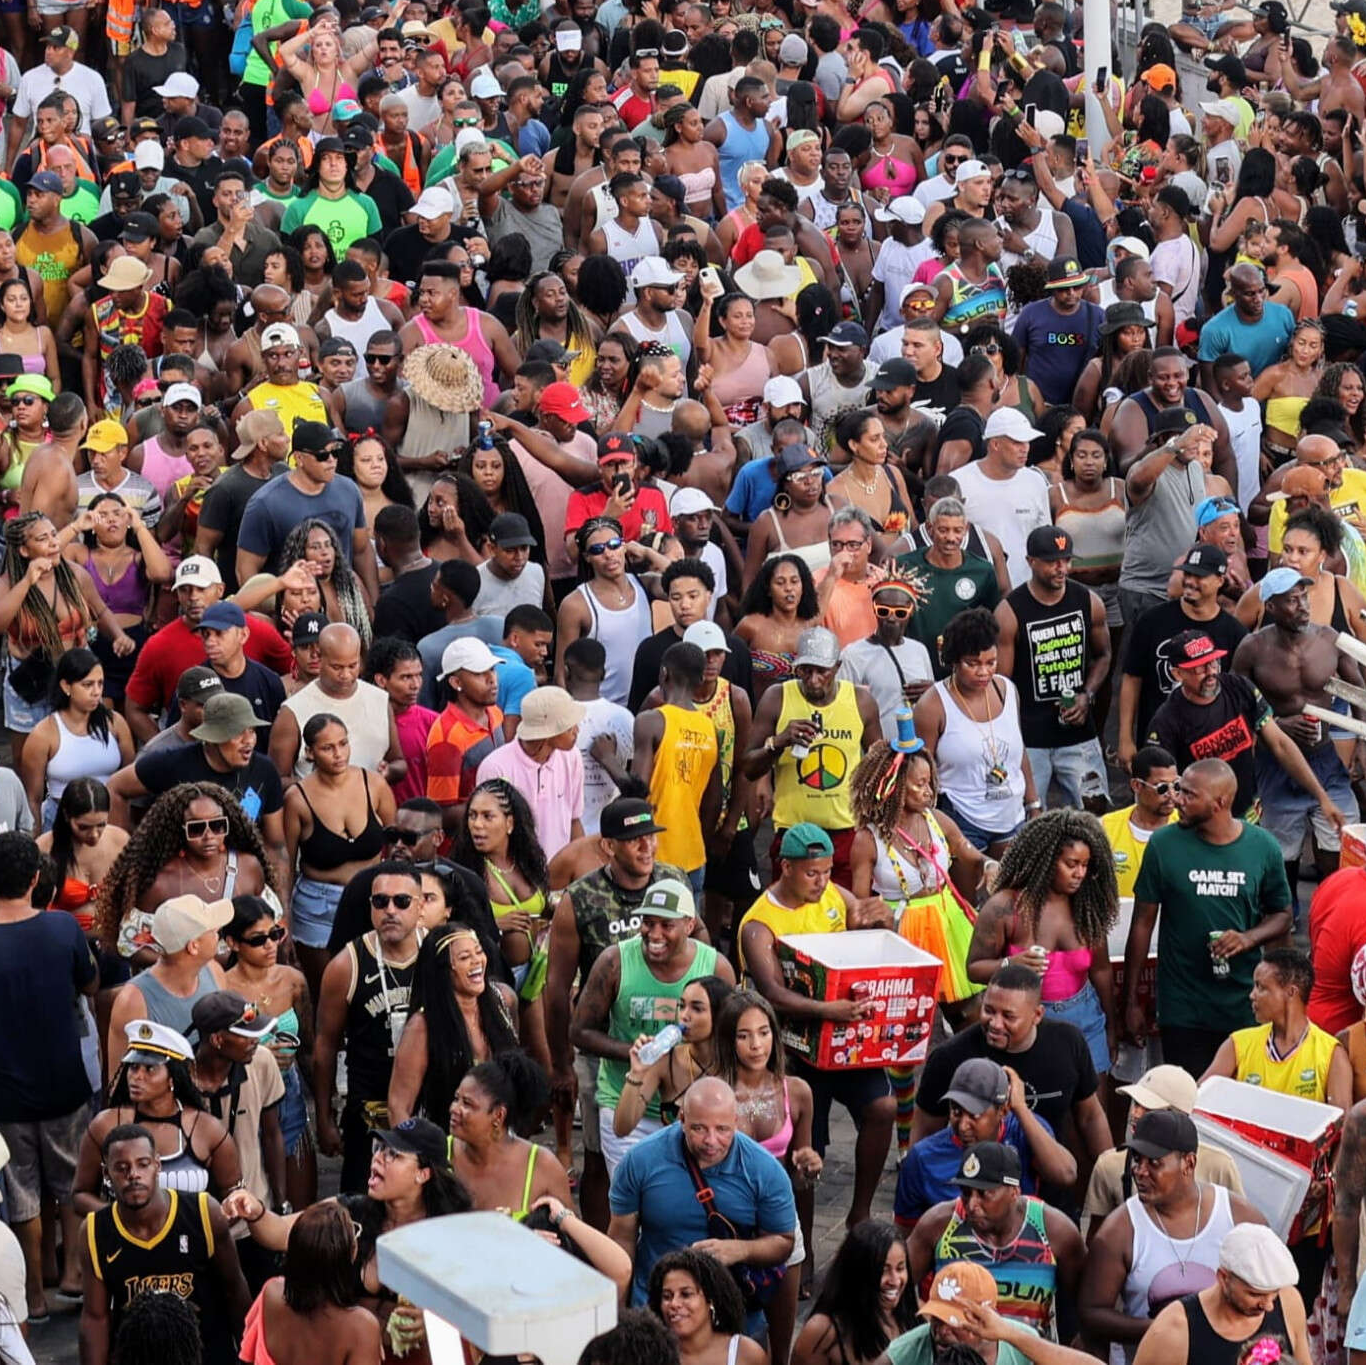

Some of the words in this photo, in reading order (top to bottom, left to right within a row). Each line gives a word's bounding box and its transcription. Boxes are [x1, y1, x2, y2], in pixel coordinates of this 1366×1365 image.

[1048, 333, 1084, 345] BOSS
[1031, 627, 1056, 643] QUEM
[1055, 622, 1070, 635] ME
[1070, 617, 1084, 632] VÊ
[1035, 649, 1061, 664] PENSA
[1061, 646, 1077, 659] QUE
[1077, 644, 1083, 655] O
[1036, 633, 1081, 655] jogando
[1038, 657, 1082, 675] Futebol
[1038, 675, 1048, 694] É
[1049, 670, 1084, 691] FÁCIL
[866, 977, 915, 998] RAHMA
